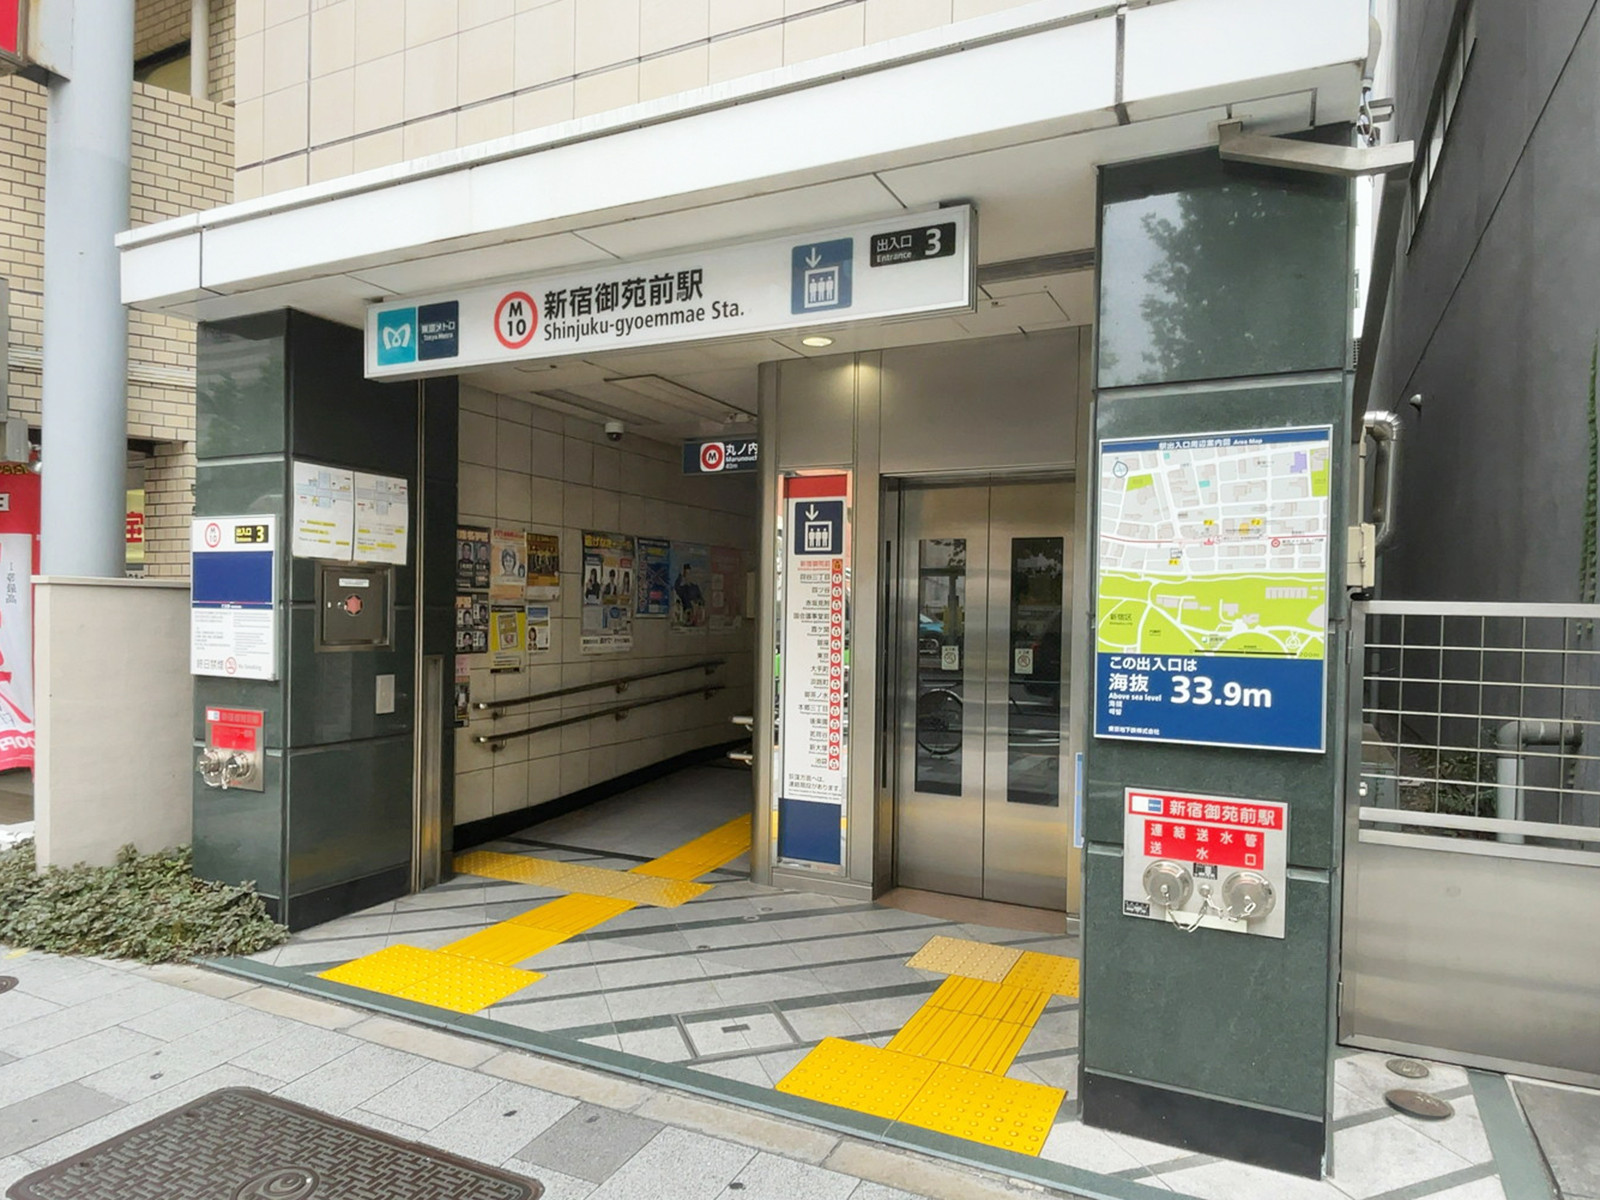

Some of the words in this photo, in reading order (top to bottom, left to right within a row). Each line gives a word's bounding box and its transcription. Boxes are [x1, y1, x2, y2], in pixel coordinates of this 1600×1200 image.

[876, 235, 912, 252] 出入口
[925, 228, 942, 256] 3
[876, 251, 912, 263] Entrance
[543, 268, 704, 321] 新宿御苑前駅
[508, 301, 523, 318] M
[507, 319, 527, 337] 10
[543, 307, 706, 342] Shinjuku-gyoemmae
[711, 300, 745, 321] Sta.
[707, 452, 717, 461] M
[726, 442, 758, 456] 丸ノ内
[256, 525, 265, 543] 3
[1109, 656, 1198, 672] この出入口は
[1108, 672, 1149, 693] 海抜
[1170, 675, 1272, 708] 33.9m
[1108, 692, 1130, 700] Above
[1144, 694, 1162, 702] level
[1169, 800, 1275, 827] 新宿御苑前駅
[1151, 823, 1258, 848] 連結送水管
[1150, 841, 1257, 867] 送水口
